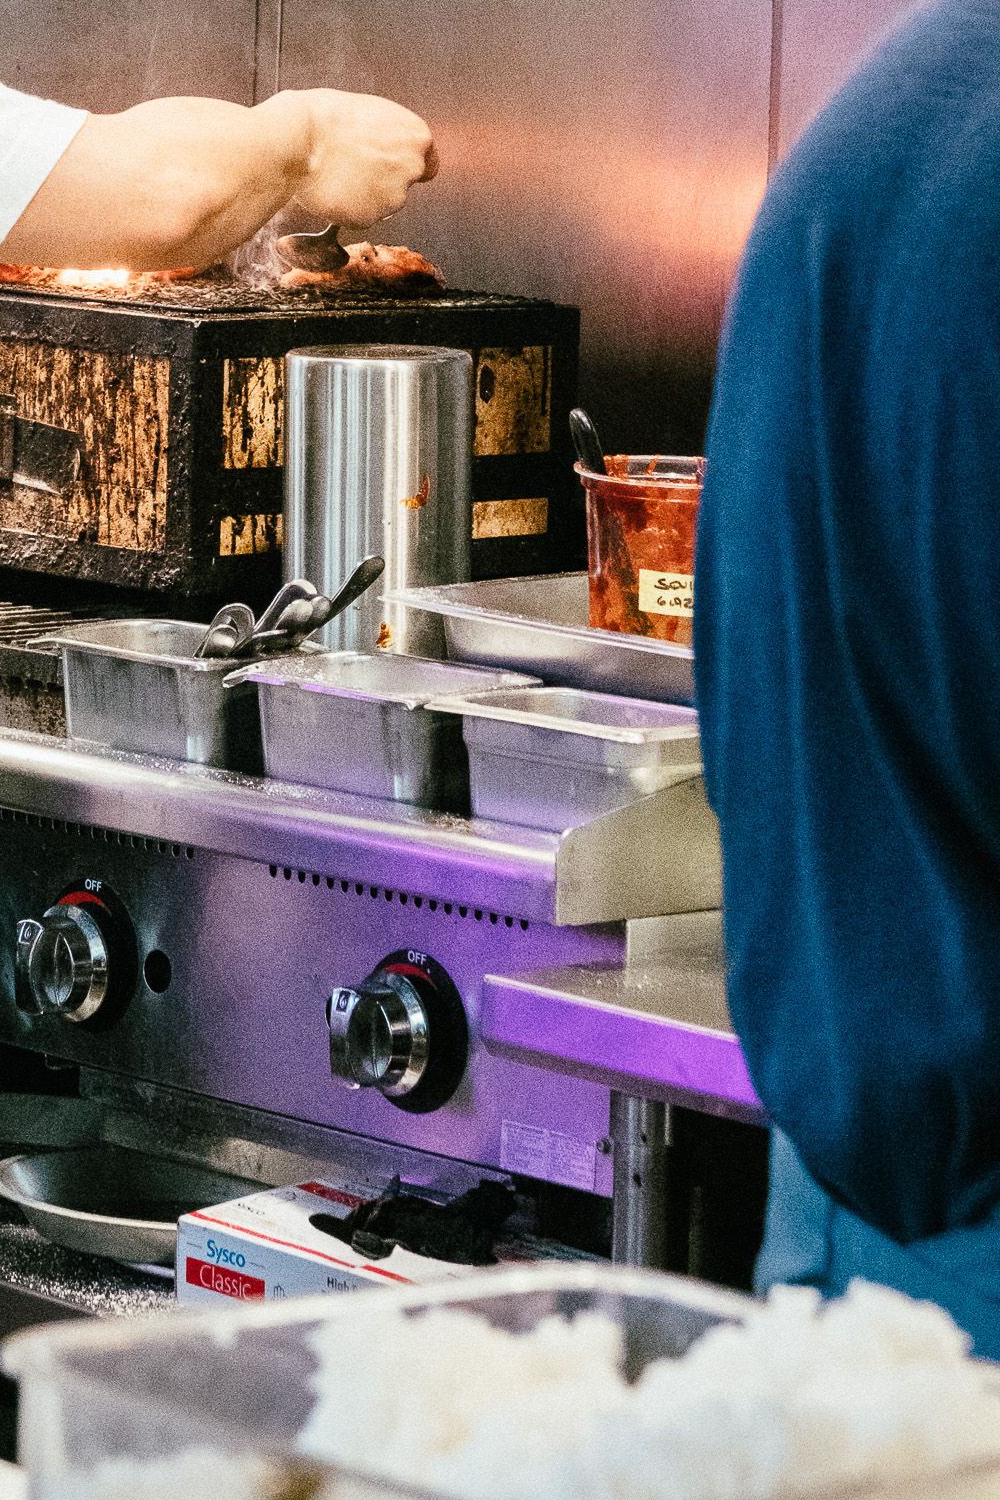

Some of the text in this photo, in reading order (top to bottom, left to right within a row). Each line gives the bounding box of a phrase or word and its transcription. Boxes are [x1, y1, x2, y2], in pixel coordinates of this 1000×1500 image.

[84, 878, 103, 892] OFF
[407, 949, 427, 965] OFF
[205, 1238, 247, 1268] Sysco
[199, 1264, 252, 1301] Classic
